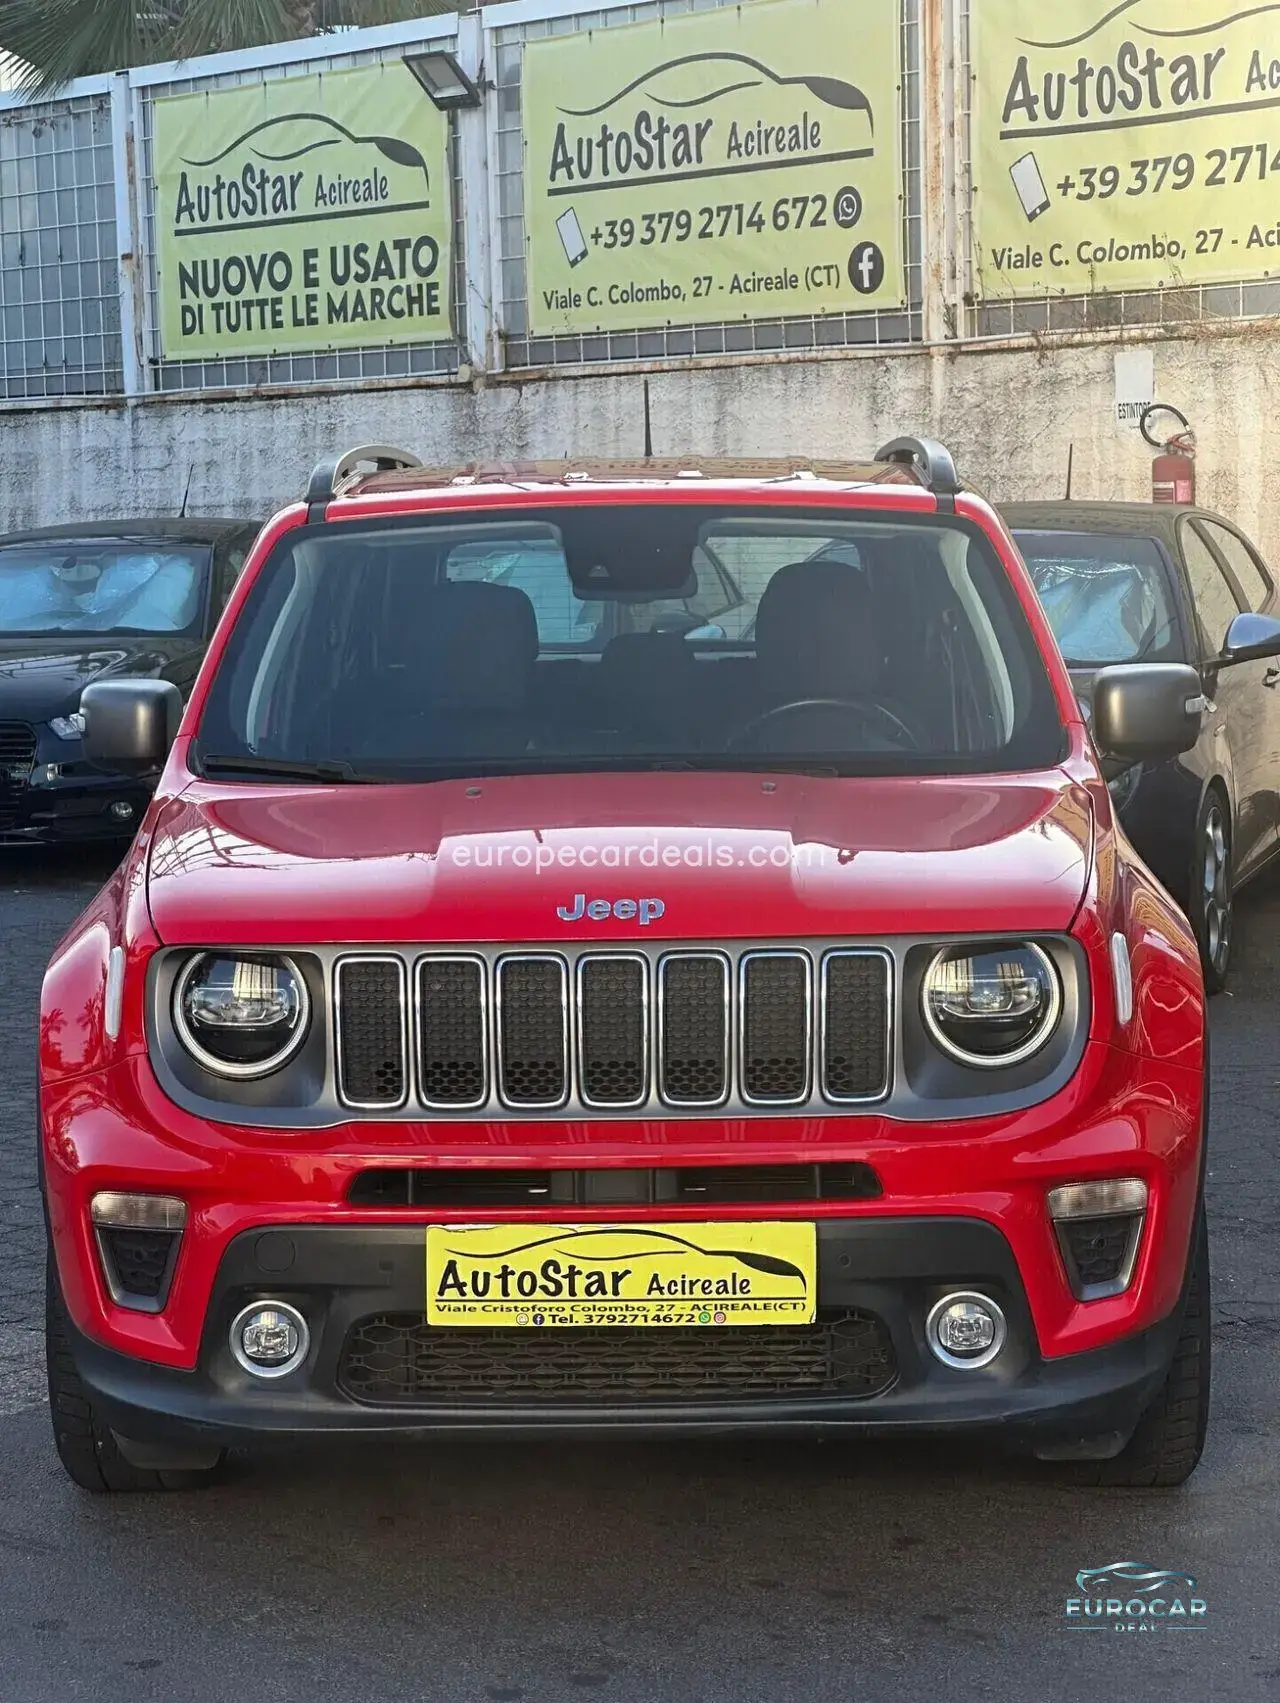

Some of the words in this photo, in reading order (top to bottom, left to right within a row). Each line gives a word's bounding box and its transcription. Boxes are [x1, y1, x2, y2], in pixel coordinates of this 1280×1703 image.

[1002, 41, 1225, 123] AutoStar
[550, 110, 713, 182] AutoStar
[727, 111, 821, 159] Acireale
[175, 163, 303, 224] AutoStar
[314, 167, 389, 208] Acireale
[1056, 165, 1120, 201] +39
[1125, 152, 1195, 197] 379
[590, 218, 635, 249] +39
[639, 209, 692, 247] 379
[698, 201, 765, 239] 2714
[772, 194, 827, 232] 672
[178, 251, 292, 299] NUOVO
[303, 248, 320, 288] E
[330, 235, 439, 286] USATO
[991, 246, 1043, 270] Viale
[1049, 243, 1070, 267] C.
[1076, 234, 1186, 265] Colombo,
[1195, 228, 1224, 255] 27
[181, 303, 204, 336] DI
[211, 296, 284, 334] TUTTE
[292, 294, 319, 328] LE
[327, 282, 440, 325] MARCHE
[543, 284, 582, 310] Viale
[587, 287, 603, 308] C.
[608, 280, 687, 305] Colombo,
[692, 276, 713, 298] 27
[729, 267, 799, 295] Acireale
[804, 264, 841, 292] (CT)
[556, 893, 666, 926] Jeep
[437, 1259, 632, 1298] AutoStar
[646, 1271, 751, 1296] Acireale
[435, 1304, 477, 1313] Viale
[481, 1304, 566, 1313] Cristoforo
[570, 1304, 650, 1313] Colombo,
[655, 1304, 676, 1312] 27
[690, 1303, 806, 1312] ACIREALE(CT)
[548, 1314, 580, 1324] Tel.
[583, 1314, 696, 1324] 3792714672
